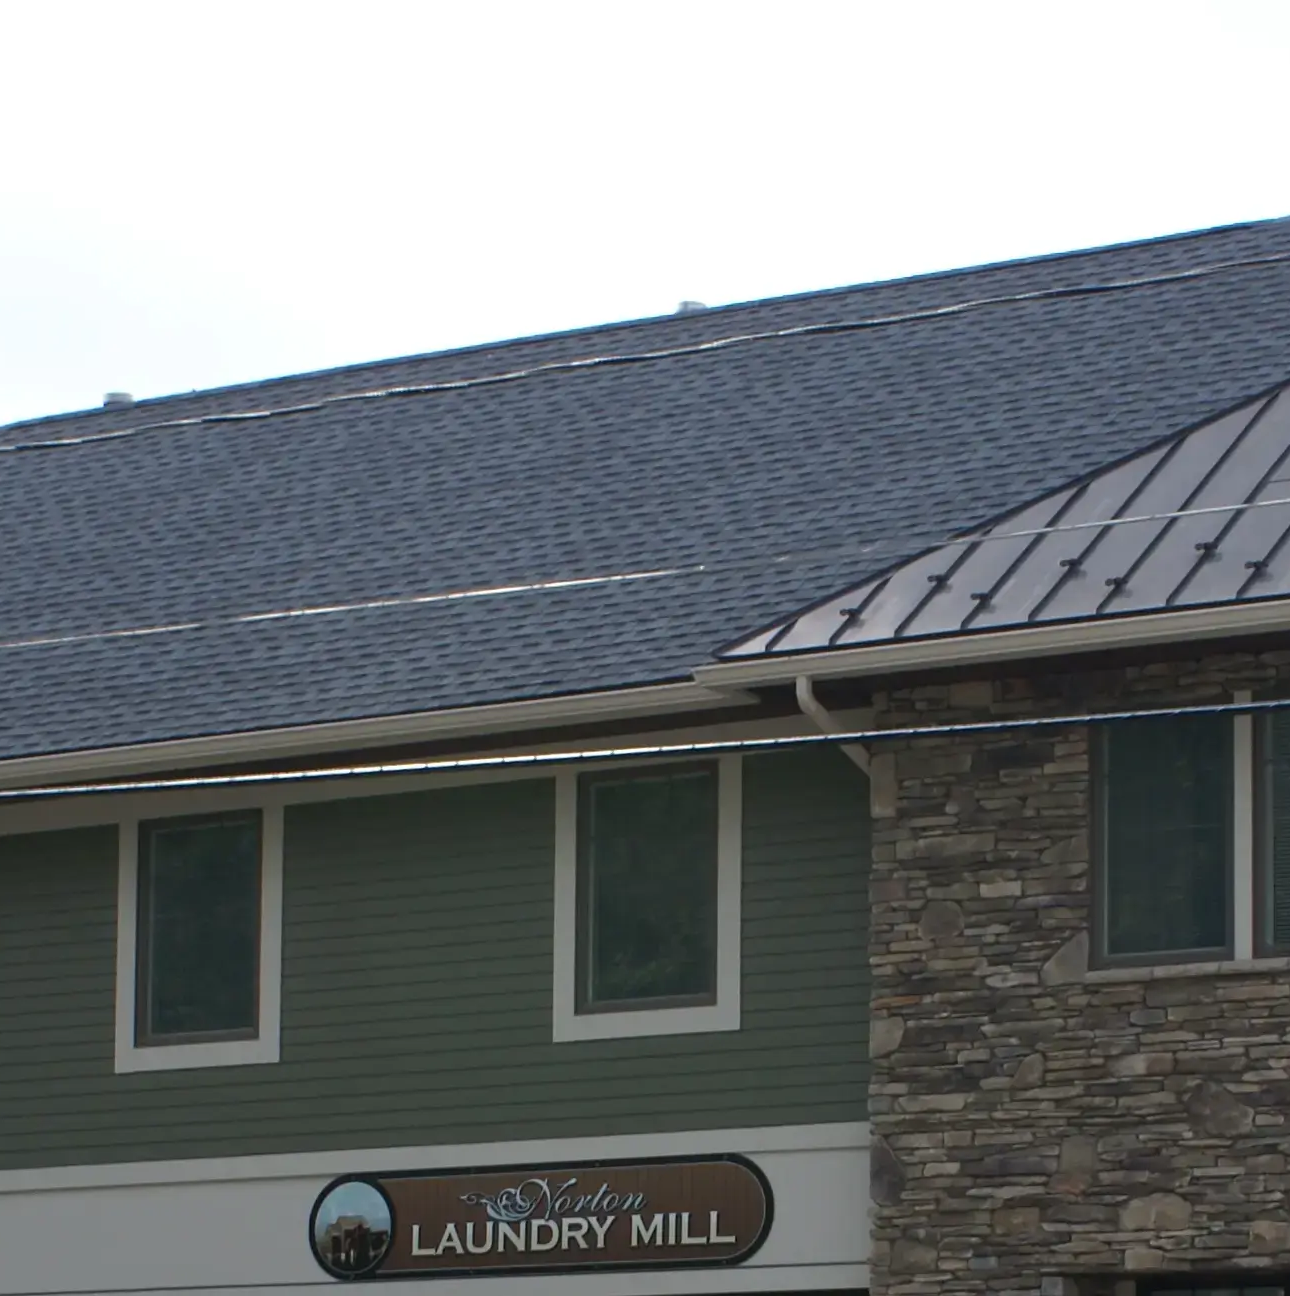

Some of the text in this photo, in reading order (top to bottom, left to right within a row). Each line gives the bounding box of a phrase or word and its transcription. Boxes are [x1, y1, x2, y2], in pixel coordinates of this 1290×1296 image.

[515, 1178, 647, 1220] Norton
[411, 1210, 737, 1257] LAUNDRY MILL
